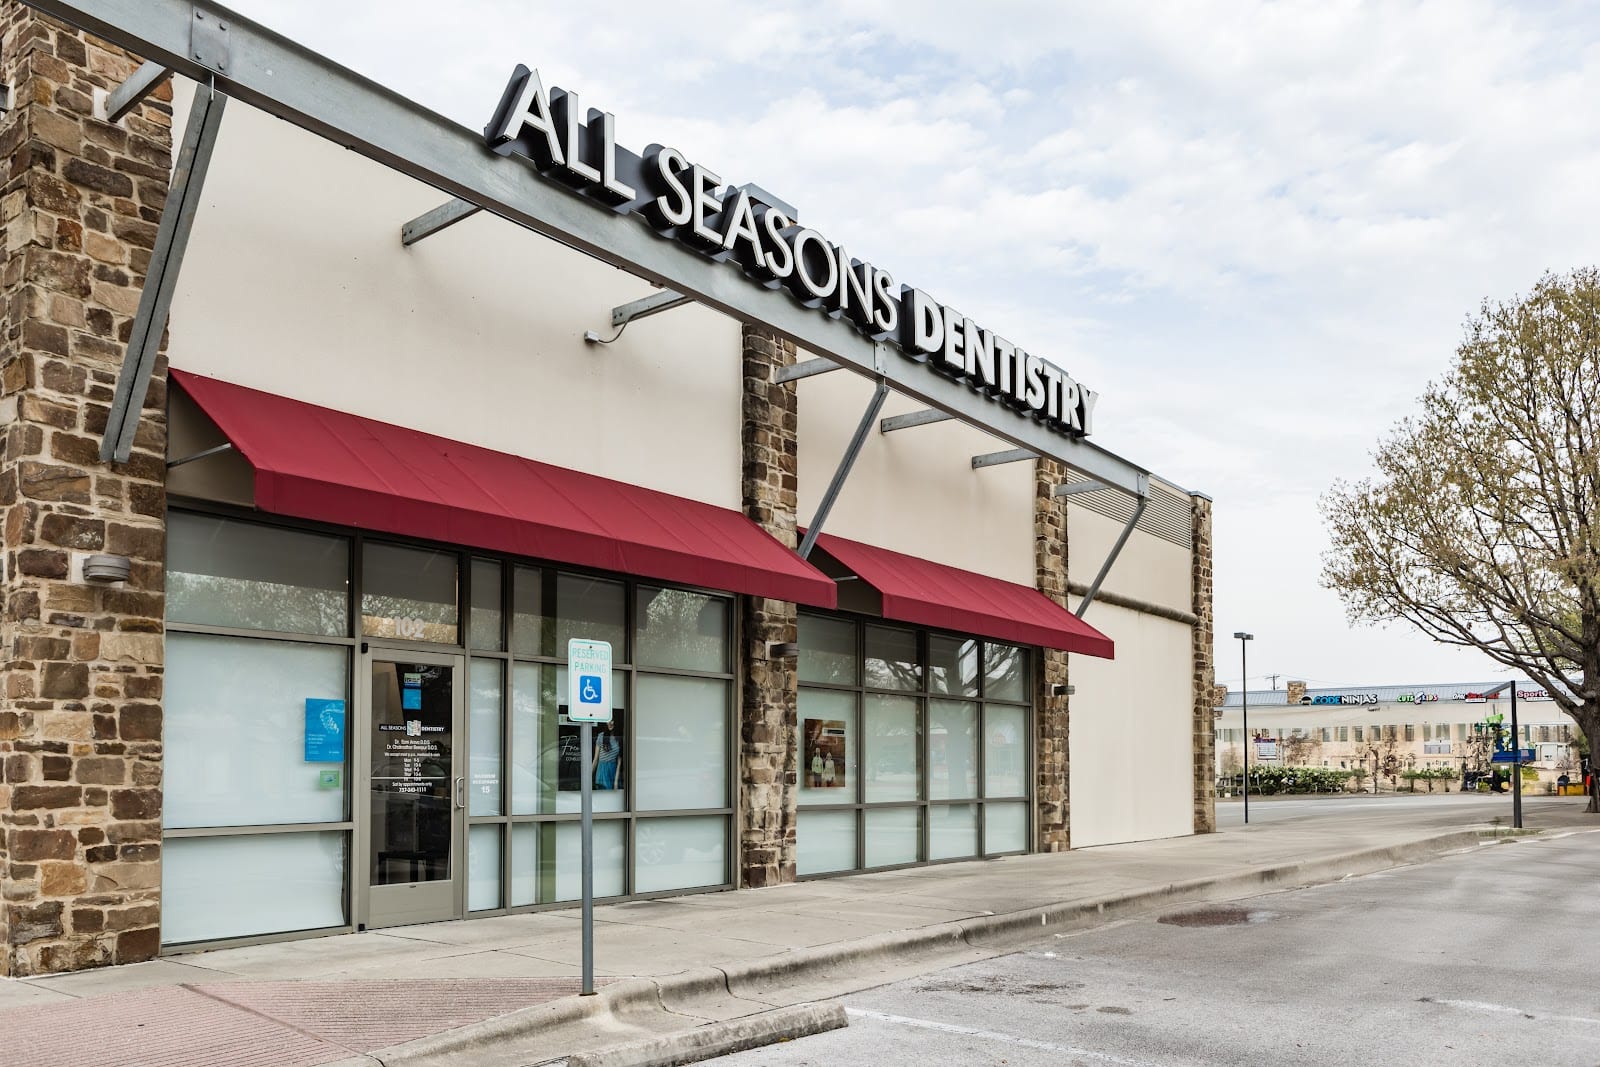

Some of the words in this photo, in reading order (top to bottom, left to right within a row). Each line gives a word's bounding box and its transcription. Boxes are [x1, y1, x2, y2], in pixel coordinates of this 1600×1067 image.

[499, 67, 637, 202] ALL
[656, 146, 898, 333] SEASONS
[913, 288, 1099, 436] DENTISTRY
[394, 616, 424, 638] 102
[572, 648, 609, 660] RESERVED
[574, 662, 606, 674] PARKING
[1313, 695, 1341, 704] CODE
[1342, 694, 1378, 705] NINJAS
